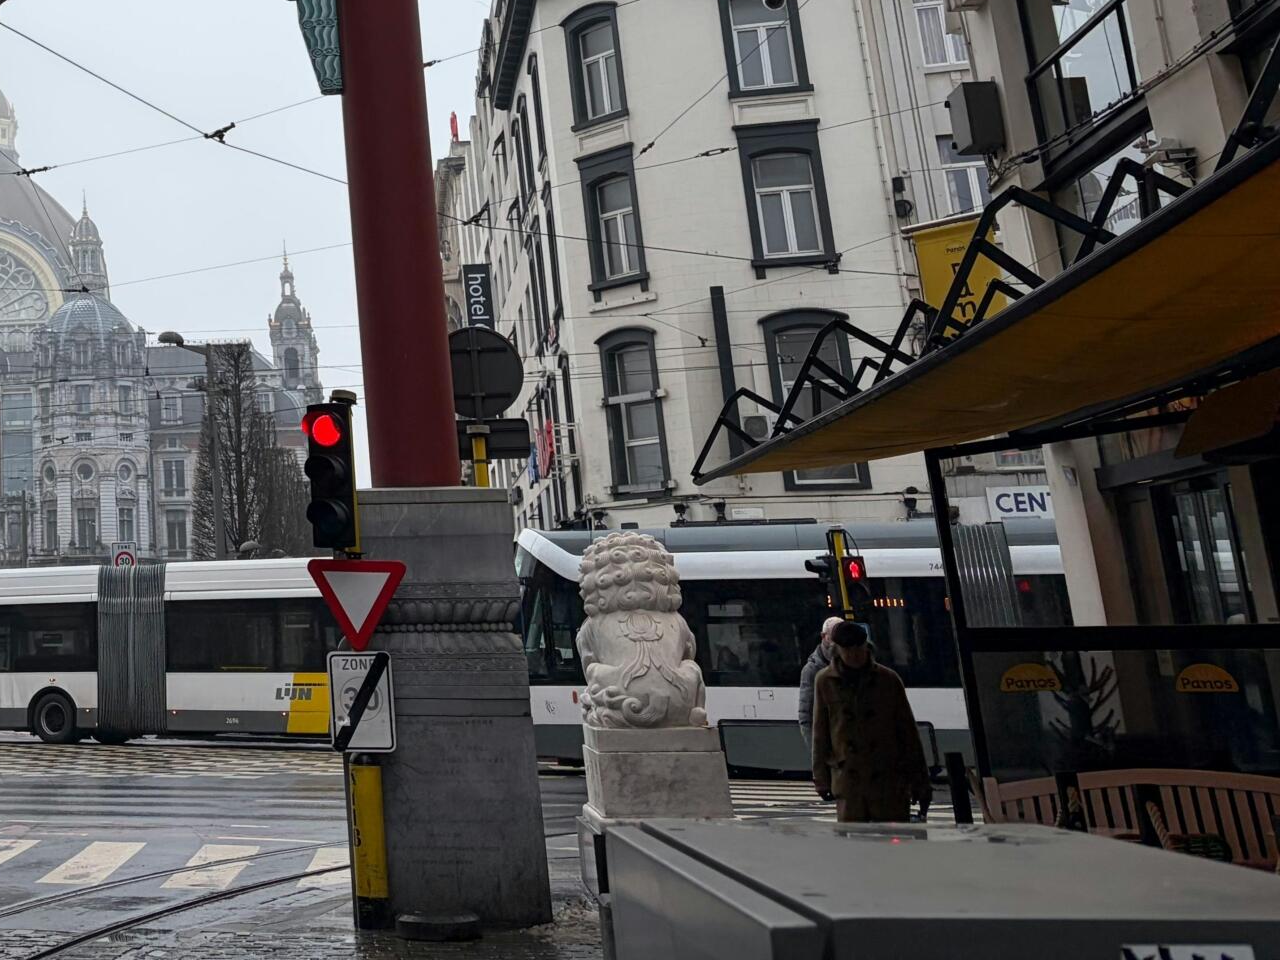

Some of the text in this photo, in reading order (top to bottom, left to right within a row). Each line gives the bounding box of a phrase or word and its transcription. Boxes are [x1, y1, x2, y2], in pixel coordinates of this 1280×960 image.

[467, 273, 490, 320] hotel
[995, 492, 1051, 514] CEN
[120, 557, 130, 566] 30
[1005, 677, 1057, 690] Panos
[1180, 677, 1233, 690] Panos
[343, 686, 380, 711] 30
